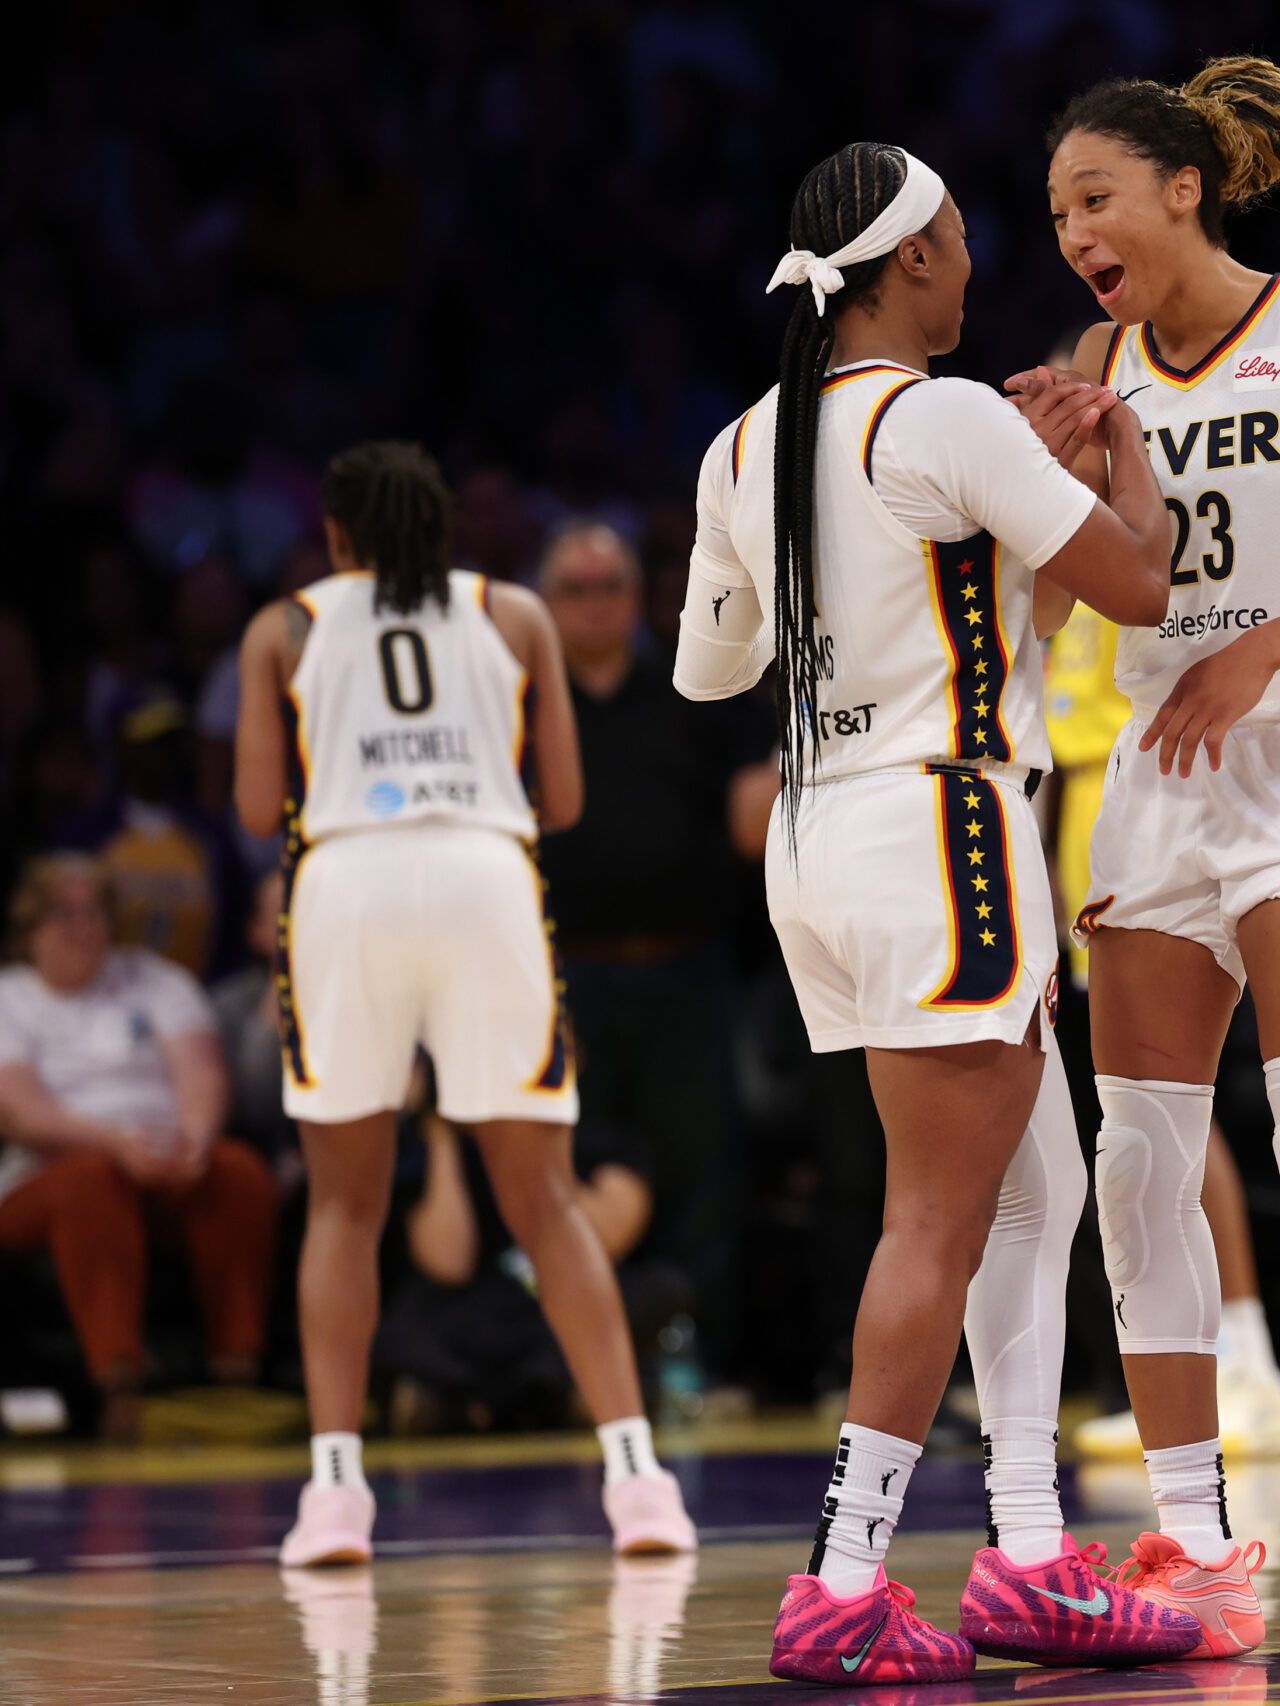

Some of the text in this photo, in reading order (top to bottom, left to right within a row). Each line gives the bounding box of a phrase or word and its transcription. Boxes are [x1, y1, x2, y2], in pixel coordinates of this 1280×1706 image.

[1166, 490, 1236, 586] 23
[1158, 604, 1268, 640] salesforce
[378, 627, 436, 715] 0
[818, 703, 877, 740] T&T
